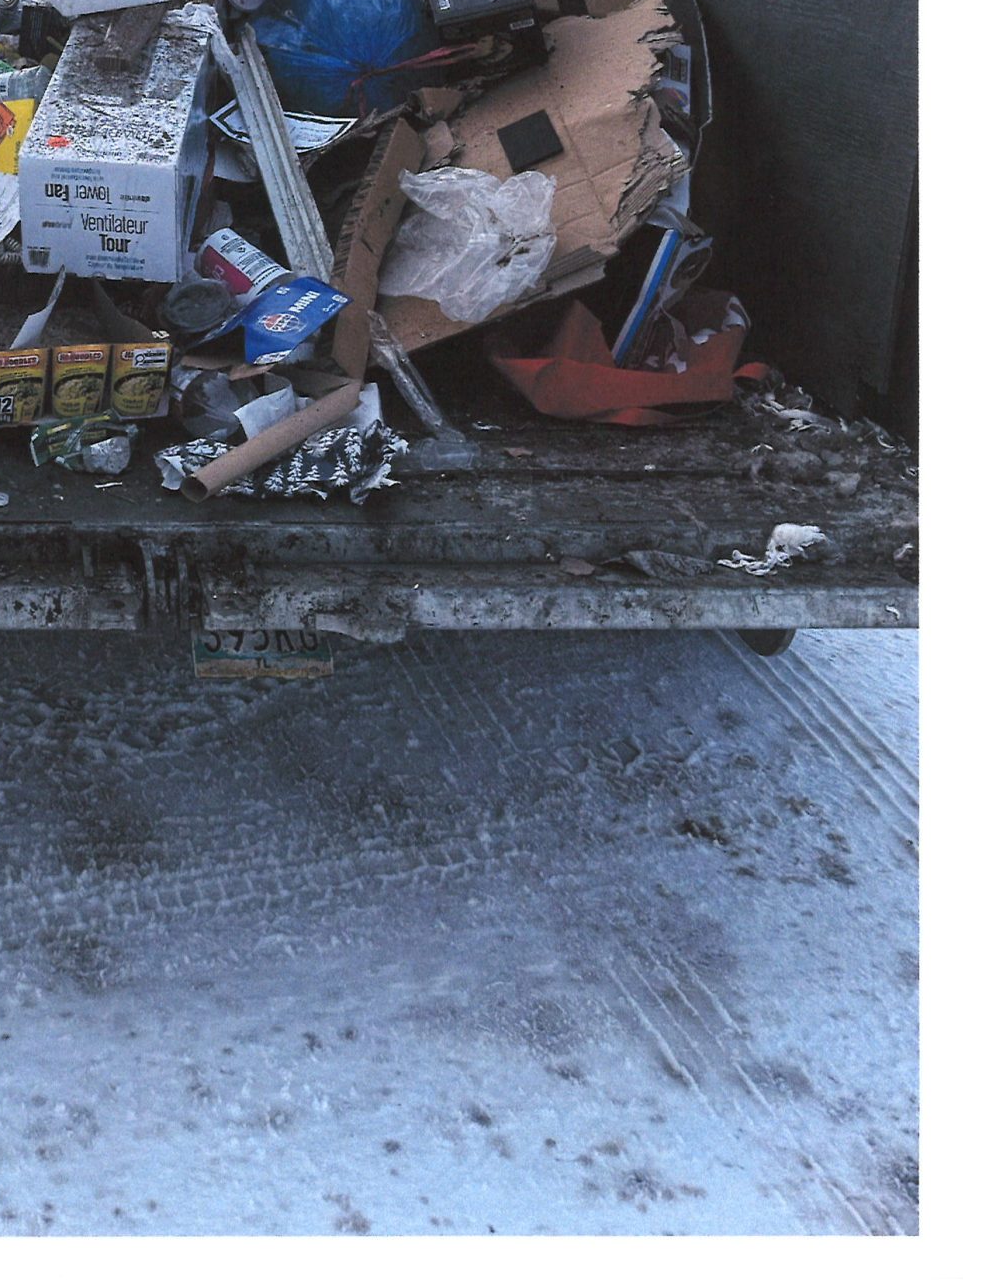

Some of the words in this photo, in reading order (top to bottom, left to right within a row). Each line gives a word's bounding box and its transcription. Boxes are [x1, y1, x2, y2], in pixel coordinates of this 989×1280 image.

[45, 183, 69, 203] Fan
[75, 184, 112, 204] Tower
[81, 213, 149, 234] Ventilateur
[99, 234, 131, 253] Tour
[288, 290, 320, 313] MINI
